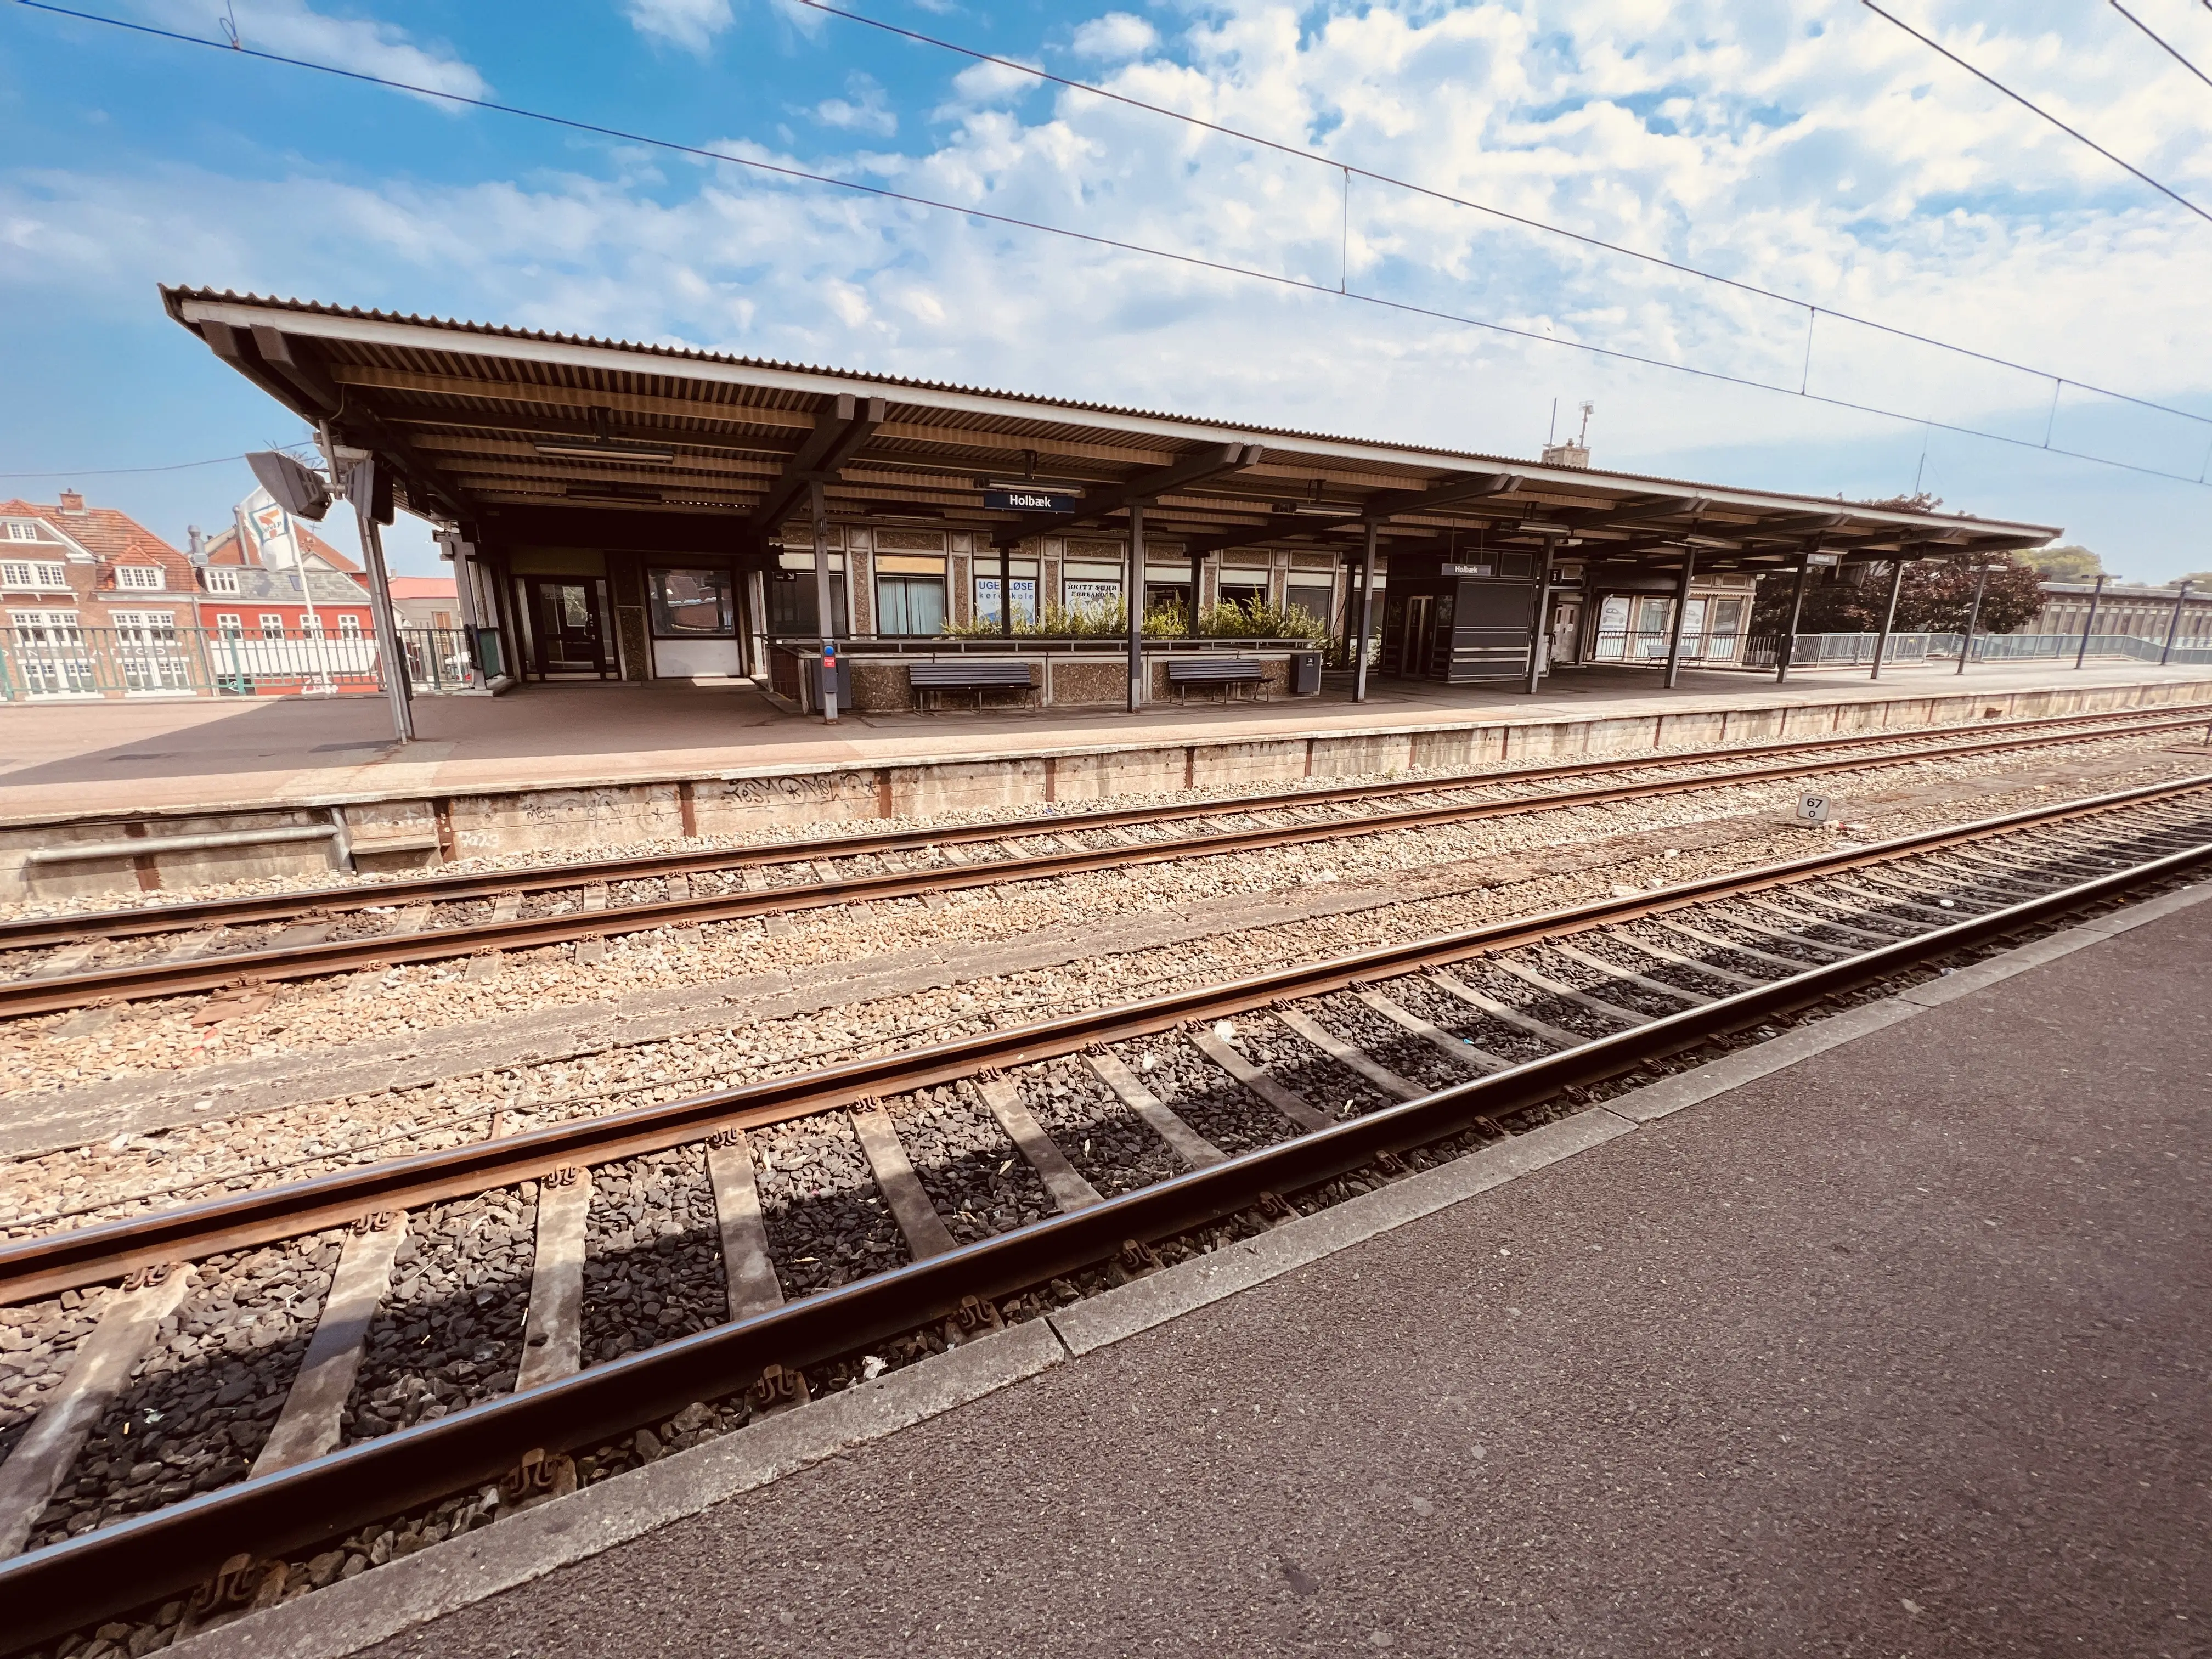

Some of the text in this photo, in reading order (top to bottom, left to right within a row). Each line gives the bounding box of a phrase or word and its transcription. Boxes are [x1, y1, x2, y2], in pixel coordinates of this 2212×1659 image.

[1009, 494, 1051, 507] Holbæk
[1455, 565, 1478, 573] Holbæk
[979, 581, 1033, 590] UGEØSE
[979, 591, 1034, 600] kørekole
[1807, 798, 1823, 808] 67
